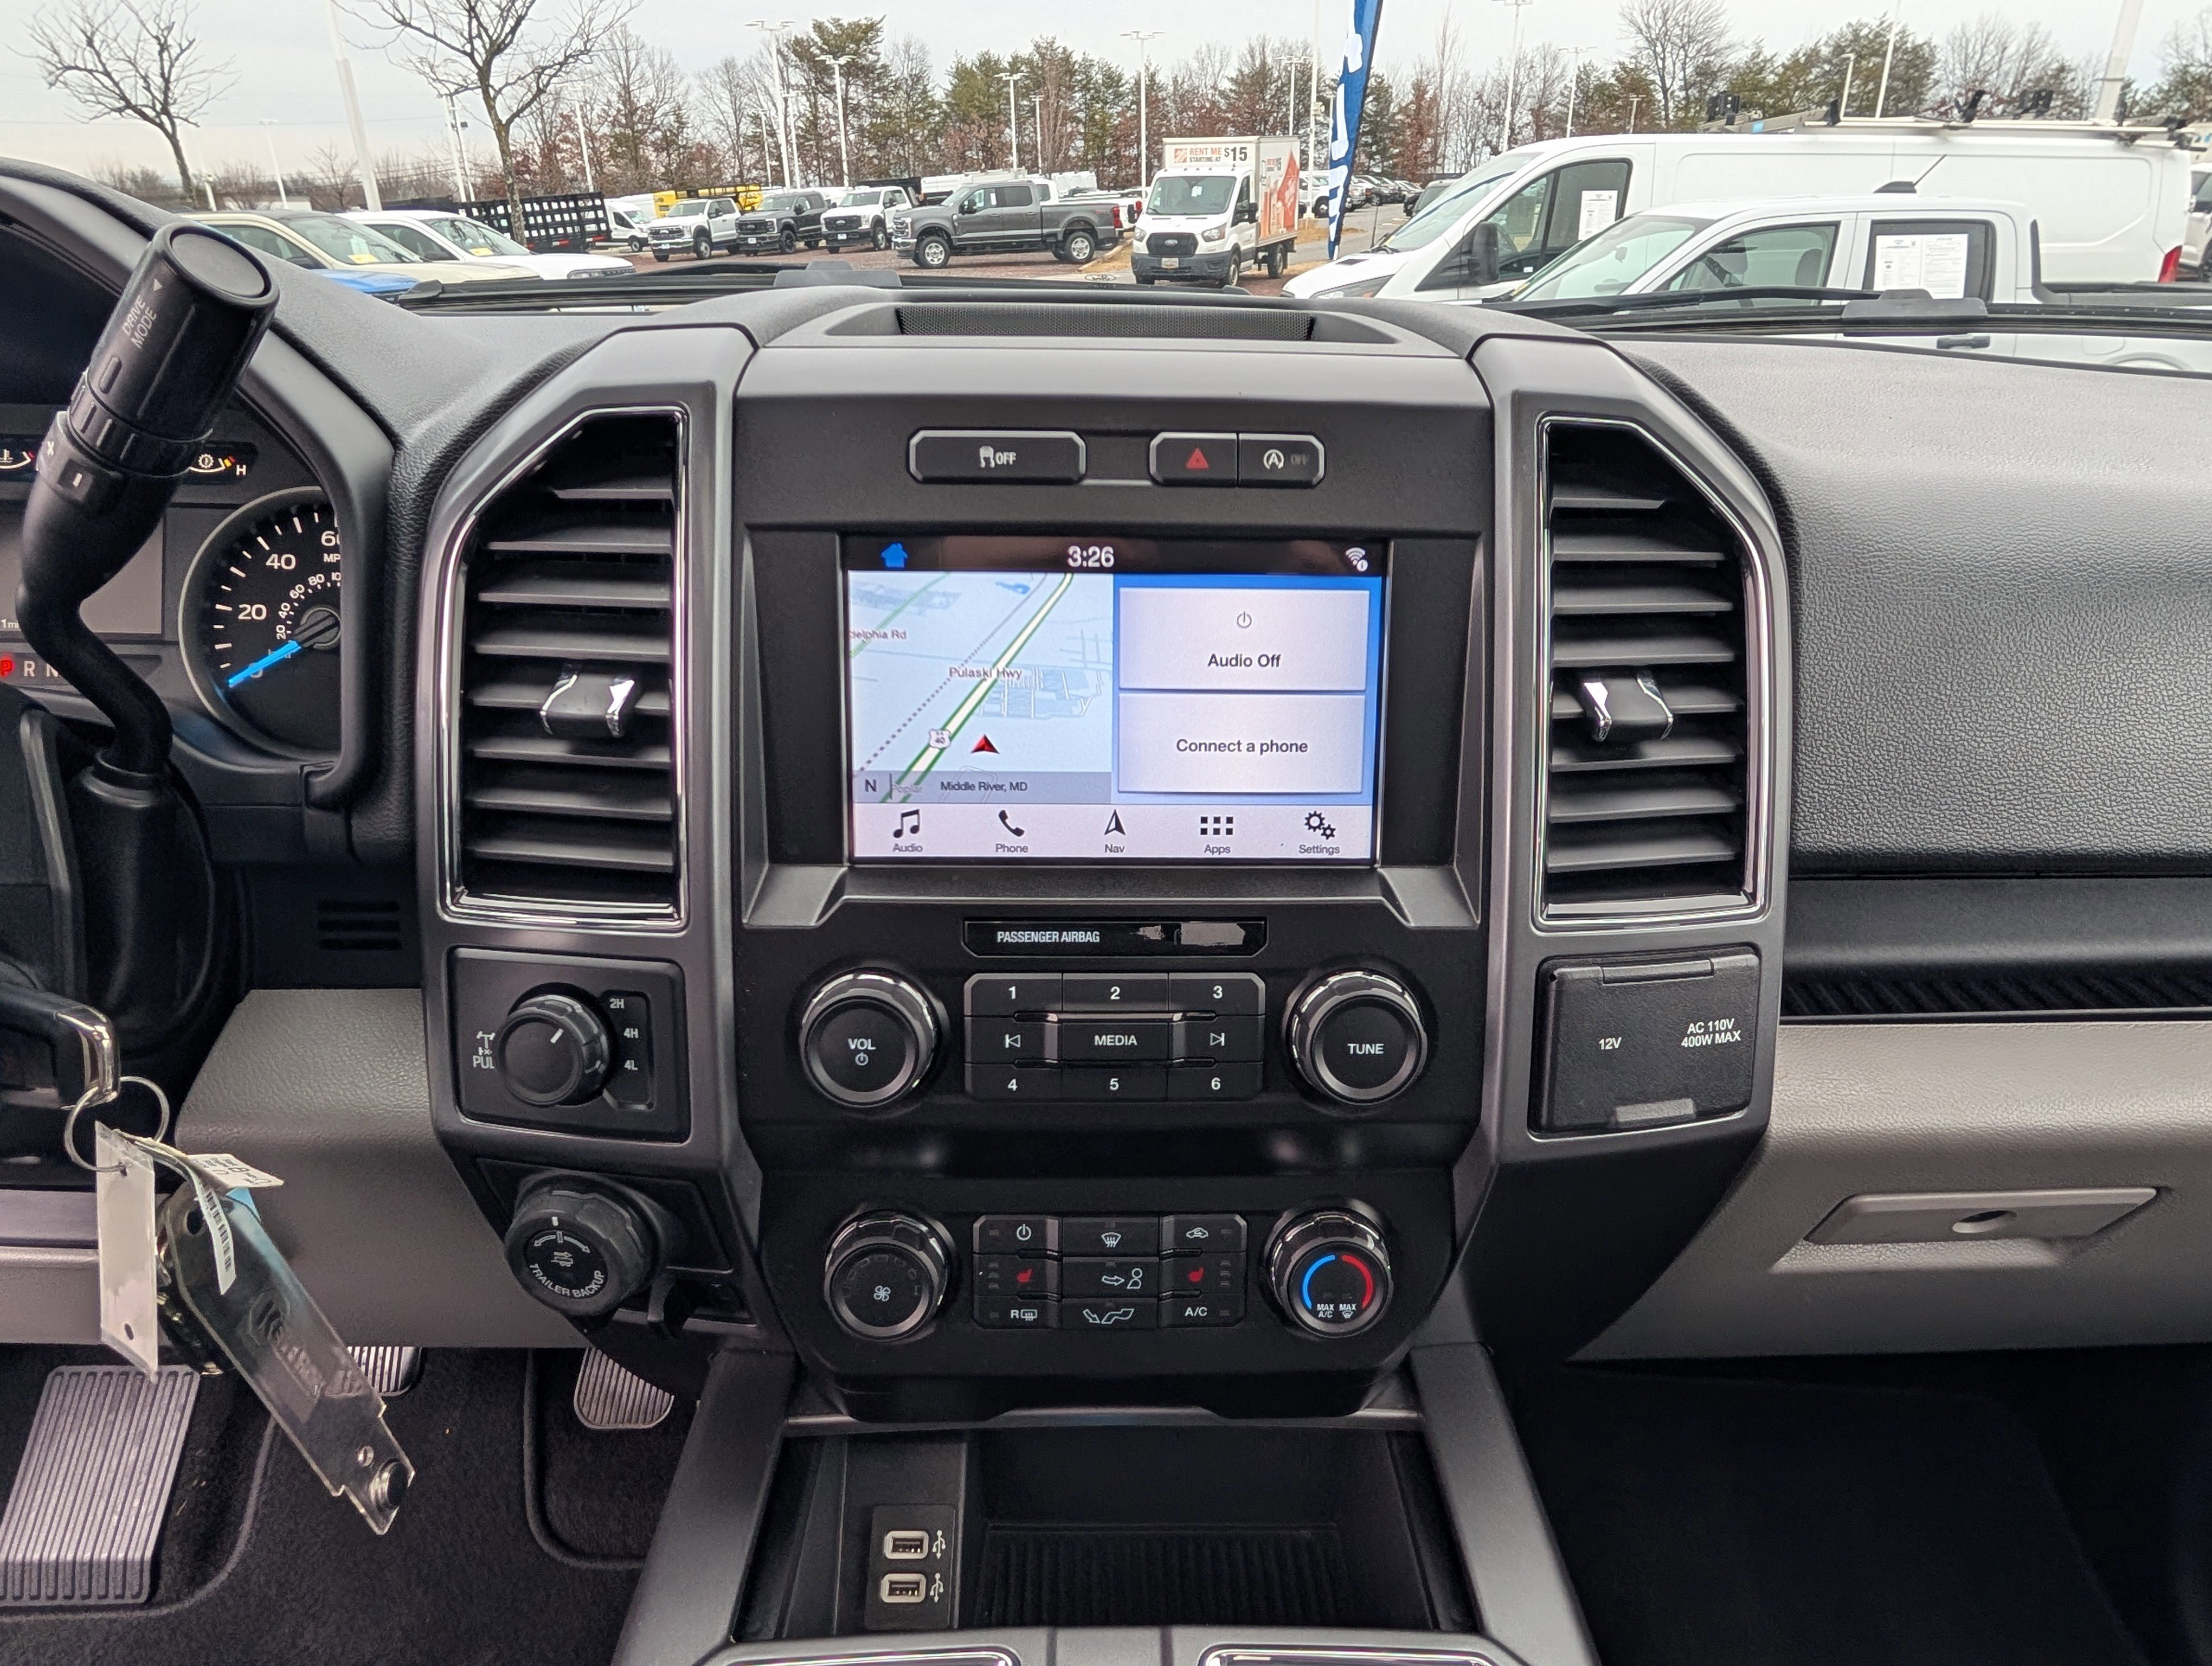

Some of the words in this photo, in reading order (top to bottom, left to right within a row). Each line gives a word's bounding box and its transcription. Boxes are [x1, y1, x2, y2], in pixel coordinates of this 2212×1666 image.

[1189, 148, 1208, 156] RENT
[1211, 147, 1222, 155] ME
[1224, 146, 1248, 162] $15
[122, 294, 145, 336] DRIVE
[131, 306, 157, 349] MODE
[996, 452, 1016, 465] OFF
[236, 465, 246, 476] H
[321, 530, 340, 547] 6
[266, 554, 296, 569] 40
[1067, 546, 1115, 568] 3:26
[308, 573, 325, 586] 80
[289, 584, 305, 599] 60
[238, 604, 267, 620] 20
[279, 603, 291, 619] 40
[276, 625, 285, 640] 20
[891, 629, 907, 639] Rd
[1207, 653, 1252, 668] Audio
[1257, 653, 1281, 668] Off
[0, 659, 12, 676] P
[24, 661, 35, 676] R
[46, 663, 59, 677] N
[949, 667, 993, 678] Pulaski
[996, 668, 1022, 681] Hwy
[1176, 738, 1242, 753] Connect
[1246, 742, 1256, 753] a
[1259, 738, 1308, 756] phone
[865, 779, 877, 792] N
[941, 781, 975, 791] Middle
[978, 781, 1007, 792] River,
[1009, 781, 1028, 791] MD
[893, 843, 923, 853] Audio
[995, 843, 1028, 853] Phone
[1104, 844, 1124, 853] Nav
[1204, 844, 1231, 855] Apps
[1298, 844, 1340, 856] Settings
[997, 932, 1059, 943] PASSENGER
[1060, 932, 1100, 943] AIRBAG
[1008, 986, 1017, 999] 1
[1110, 987, 1120, 1000] 2
[1213, 986, 1223, 999] 3
[609, 998, 625, 1009] 2H
[1687, 1022, 1705, 1034] AC
[1707, 1018, 1735, 1032] 110V
[623, 1028, 639, 1039] 4H
[1681, 1034, 1713, 1048] 400W
[1715, 1030, 1741, 1044] MAX
[847, 1038, 876, 1050] VOL
[1094, 1035, 1137, 1046] MEDIA
[1599, 1037, 1622, 1050] 12V
[1347, 1043, 1384, 1054] TUNE
[623, 1060, 638, 1071] 4L
[1008, 1079, 1017, 1091] 4
[1110, 1078, 1119, 1090] 5
[1211, 1078, 1221, 1090] 6
[529, 1263, 570, 1297] TRAILER
[572, 1270, 605, 1298] BACKUP
[1185, 1306, 1208, 1317] A/C
[1317, 1303, 1334, 1311] MAX
[1339, 1303, 1356, 1311] MAX
